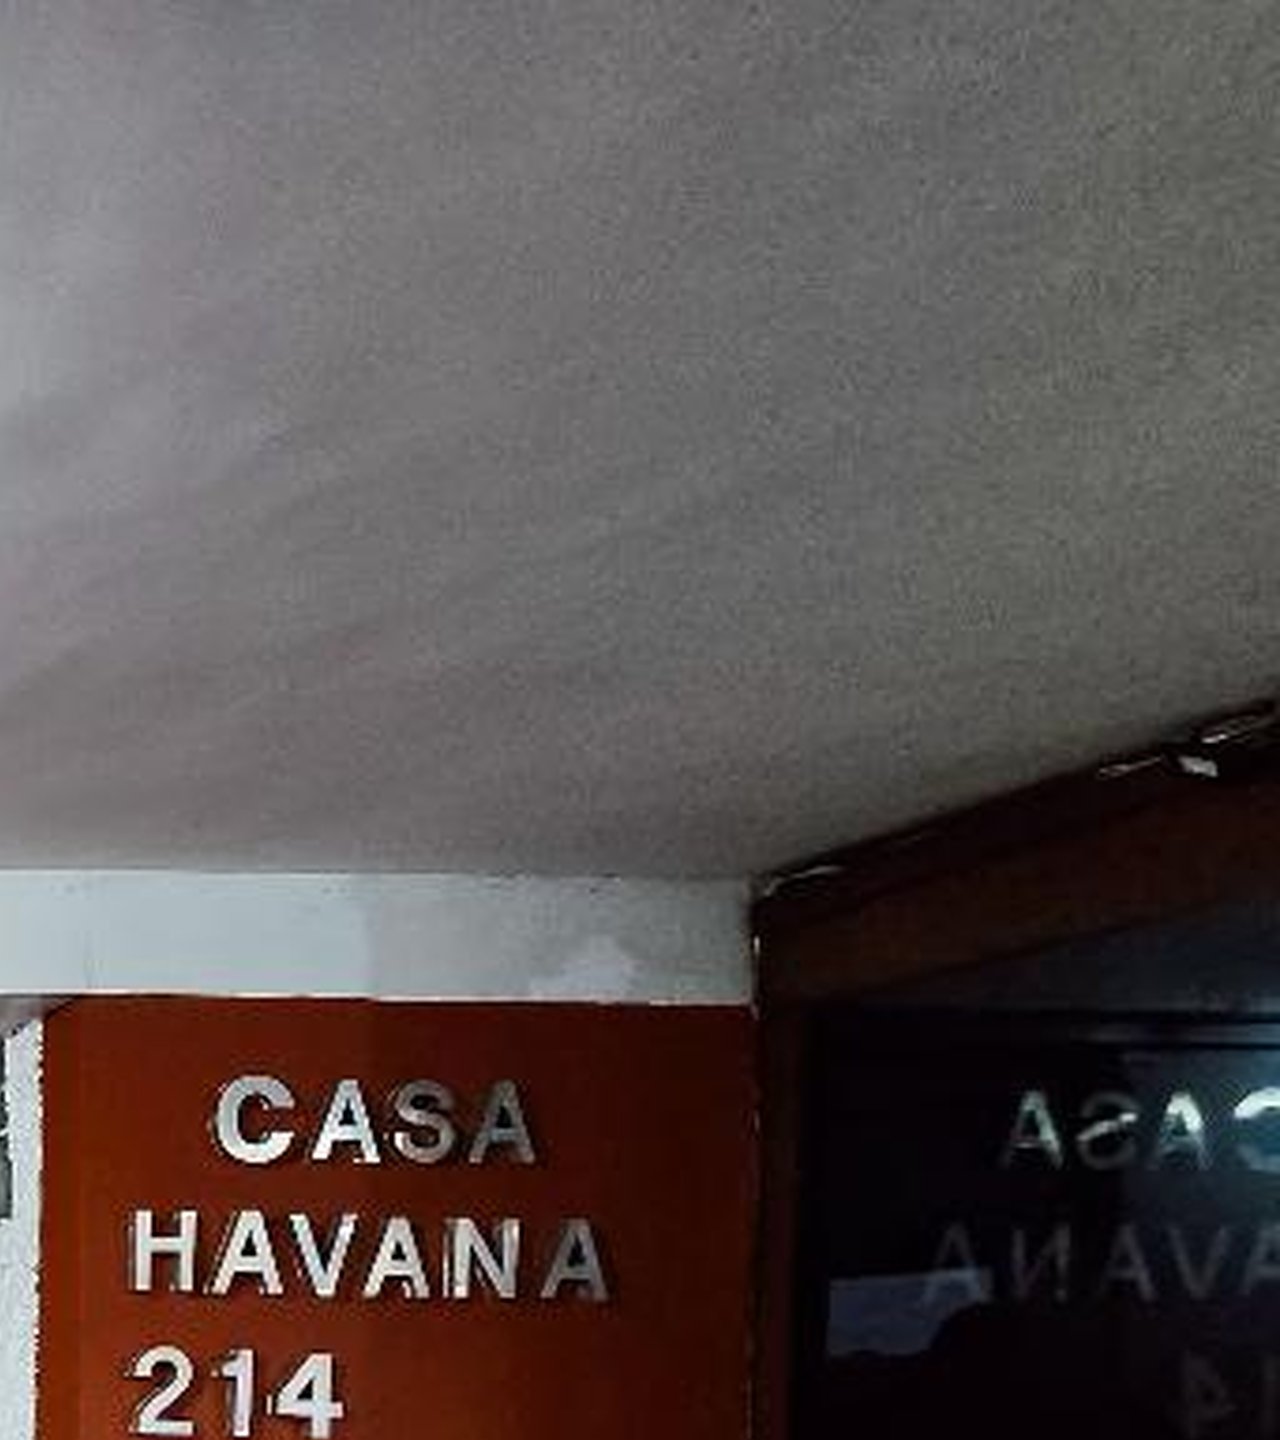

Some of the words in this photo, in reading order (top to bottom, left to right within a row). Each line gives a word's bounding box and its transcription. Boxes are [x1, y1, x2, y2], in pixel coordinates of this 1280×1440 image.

[214, 1074, 537, 1164] CASA
[129, 1208, 610, 1299] HAVANA
[128, 1344, 343, 1440] 214
